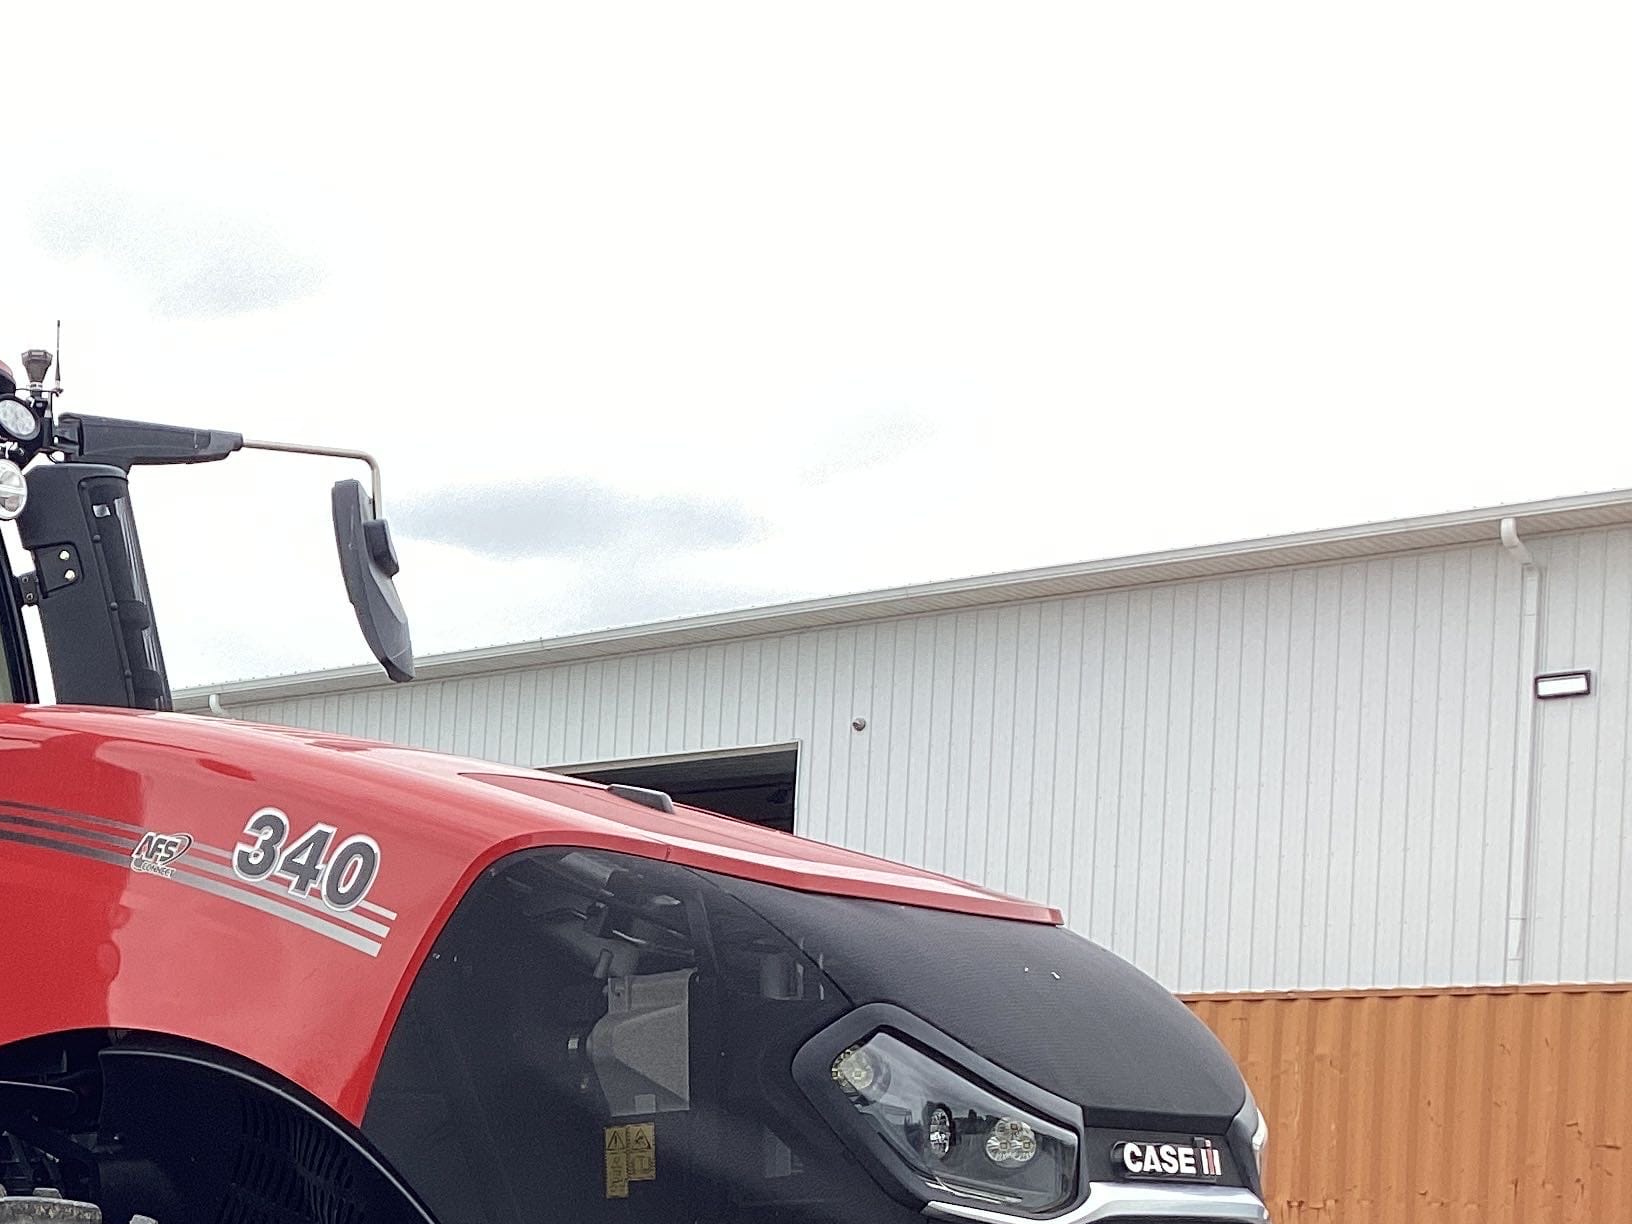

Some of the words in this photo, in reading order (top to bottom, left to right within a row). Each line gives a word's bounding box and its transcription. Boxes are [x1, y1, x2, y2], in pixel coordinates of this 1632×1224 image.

[132, 832, 180, 862] AFS
[233, 807, 381, 911] 340
[142, 861, 176, 878] CONNECT
[1123, 1142, 1197, 1174] CASE
